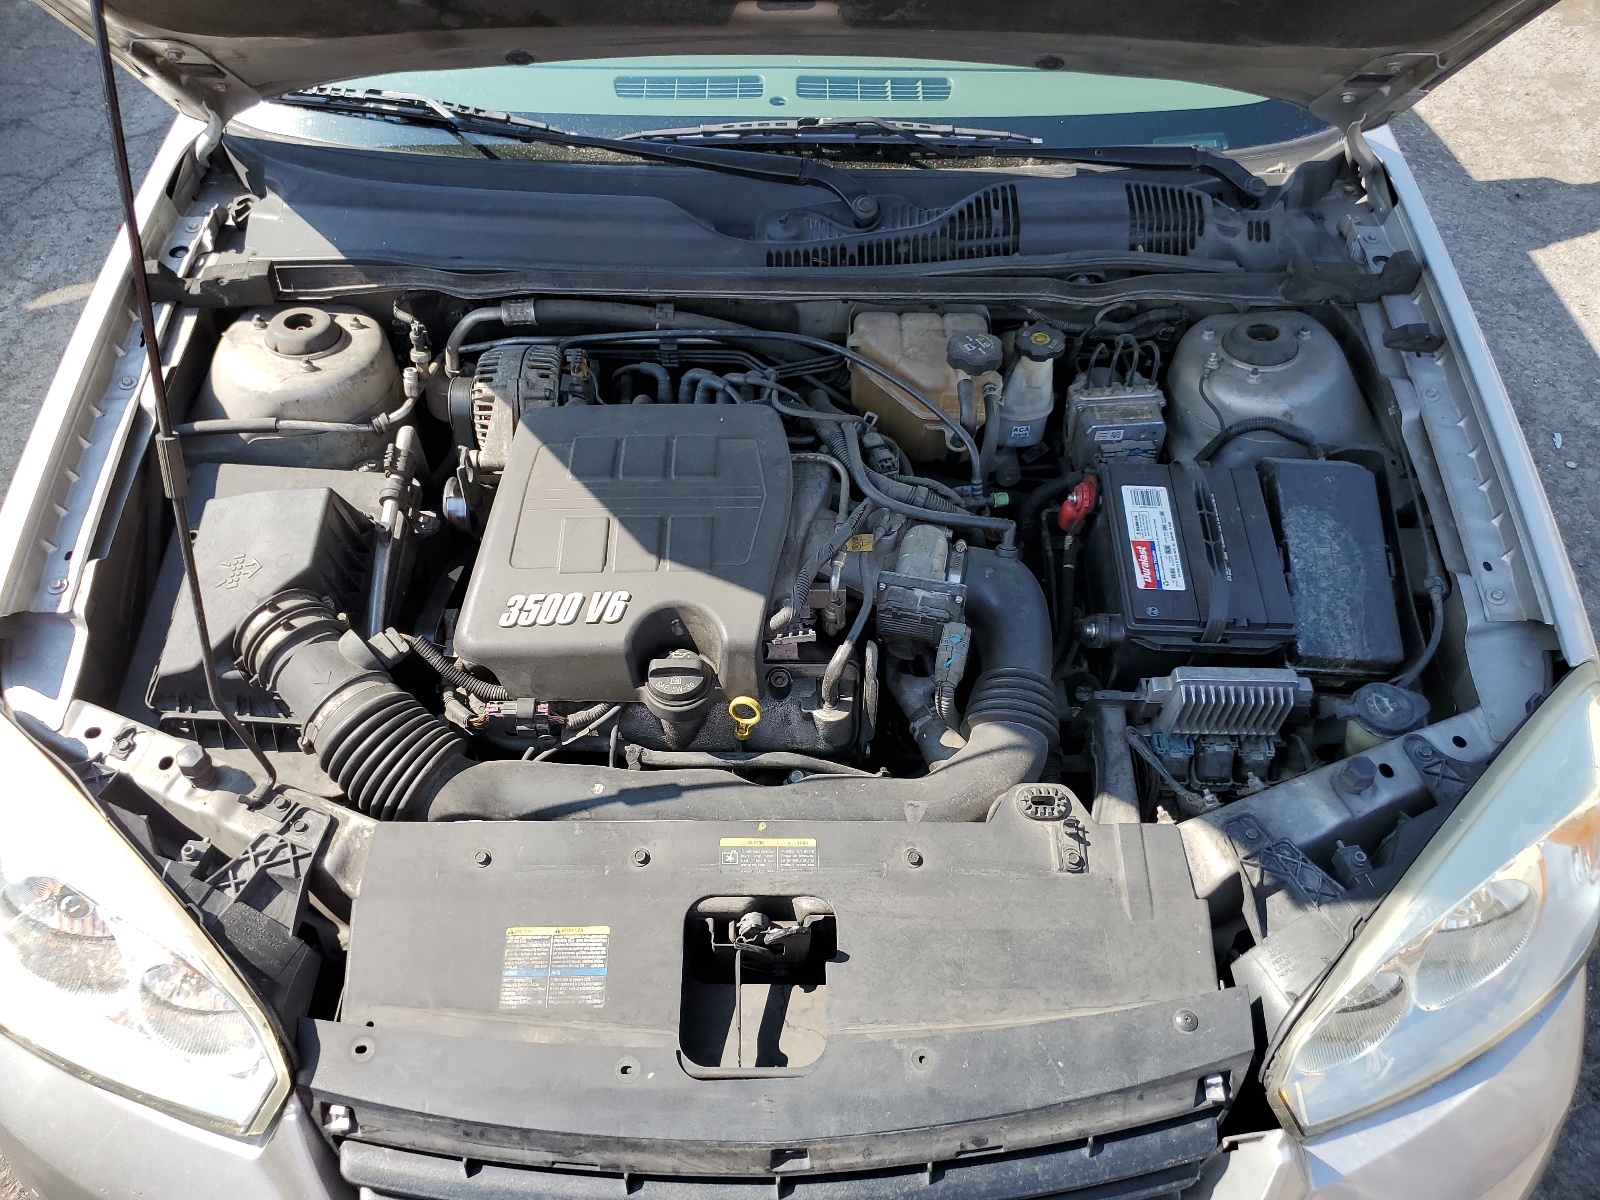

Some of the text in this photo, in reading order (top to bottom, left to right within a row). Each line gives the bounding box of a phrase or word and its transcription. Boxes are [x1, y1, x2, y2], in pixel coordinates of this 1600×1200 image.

[1136, 545, 1152, 583] Duralast
[499, 591, 632, 628] 3500 V6
[655, 681, 695, 692] SAE 5W-30
